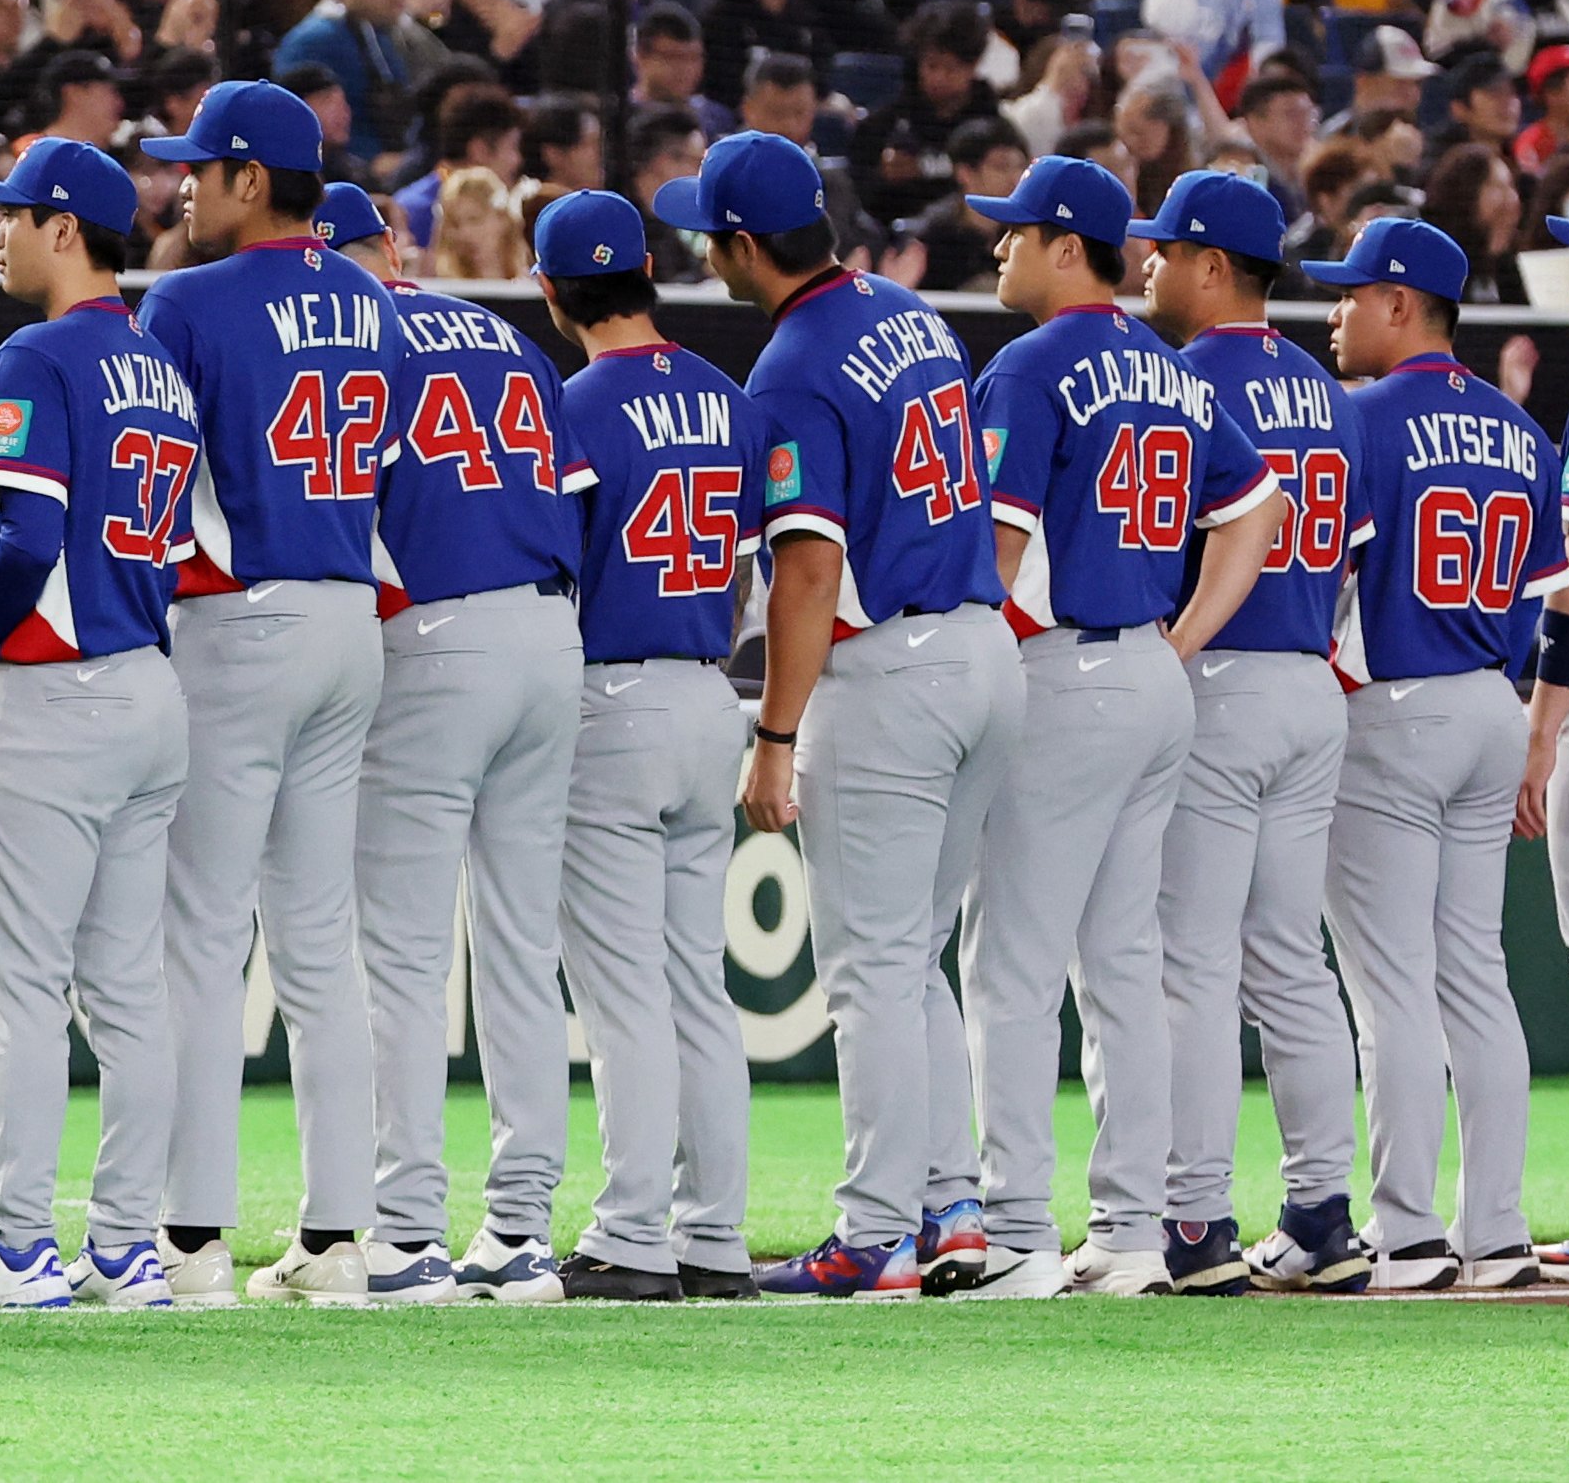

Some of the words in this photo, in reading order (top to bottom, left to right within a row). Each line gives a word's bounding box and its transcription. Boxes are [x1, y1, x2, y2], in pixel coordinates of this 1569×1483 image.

[266, 293, 379, 355] W.E.LIN
[841, 310, 961, 402] H.C.CHENG
[266, 370, 389, 500] 42
[407, 371, 558, 496] 44
[621, 392, 729, 451] Y.M.LIN
[892, 378, 981, 526] 47
[1058, 350, 1214, 431] C.Z.A.ZHUANG
[1245, 376, 1333, 433] C.W.HU
[1406, 413, 1537, 482] J.Y.TSENG
[101, 427, 198, 570] 37
[622, 467, 743, 598] 45
[1095, 423, 1193, 552] 48
[1255, 448, 1349, 573] 58
[1413, 485, 1533, 613] 60
